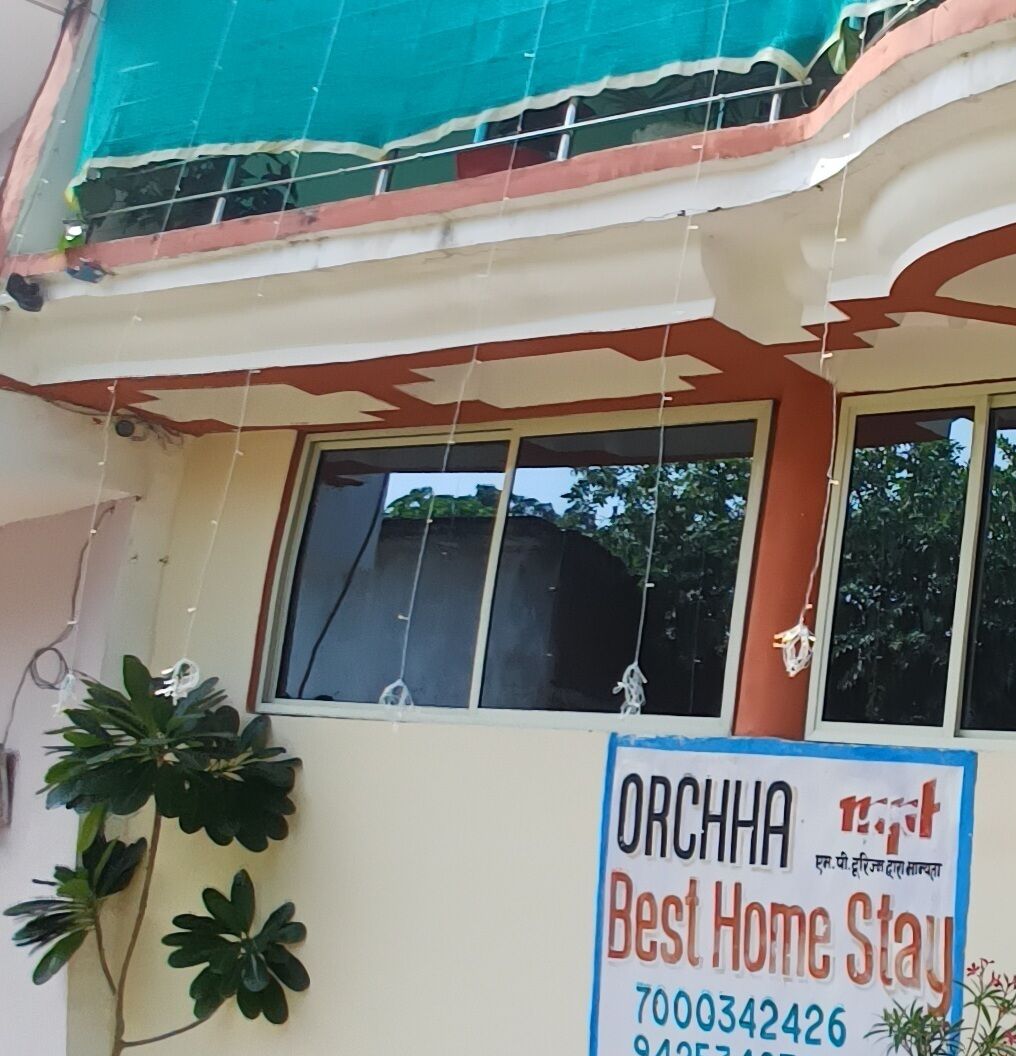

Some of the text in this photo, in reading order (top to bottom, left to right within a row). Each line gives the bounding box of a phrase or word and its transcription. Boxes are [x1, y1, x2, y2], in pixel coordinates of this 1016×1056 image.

[617, 772, 793, 868] ORCHHA
[608, 871, 954, 1017] Best Home Stay
[636, 986, 847, 1048] 7000342426
